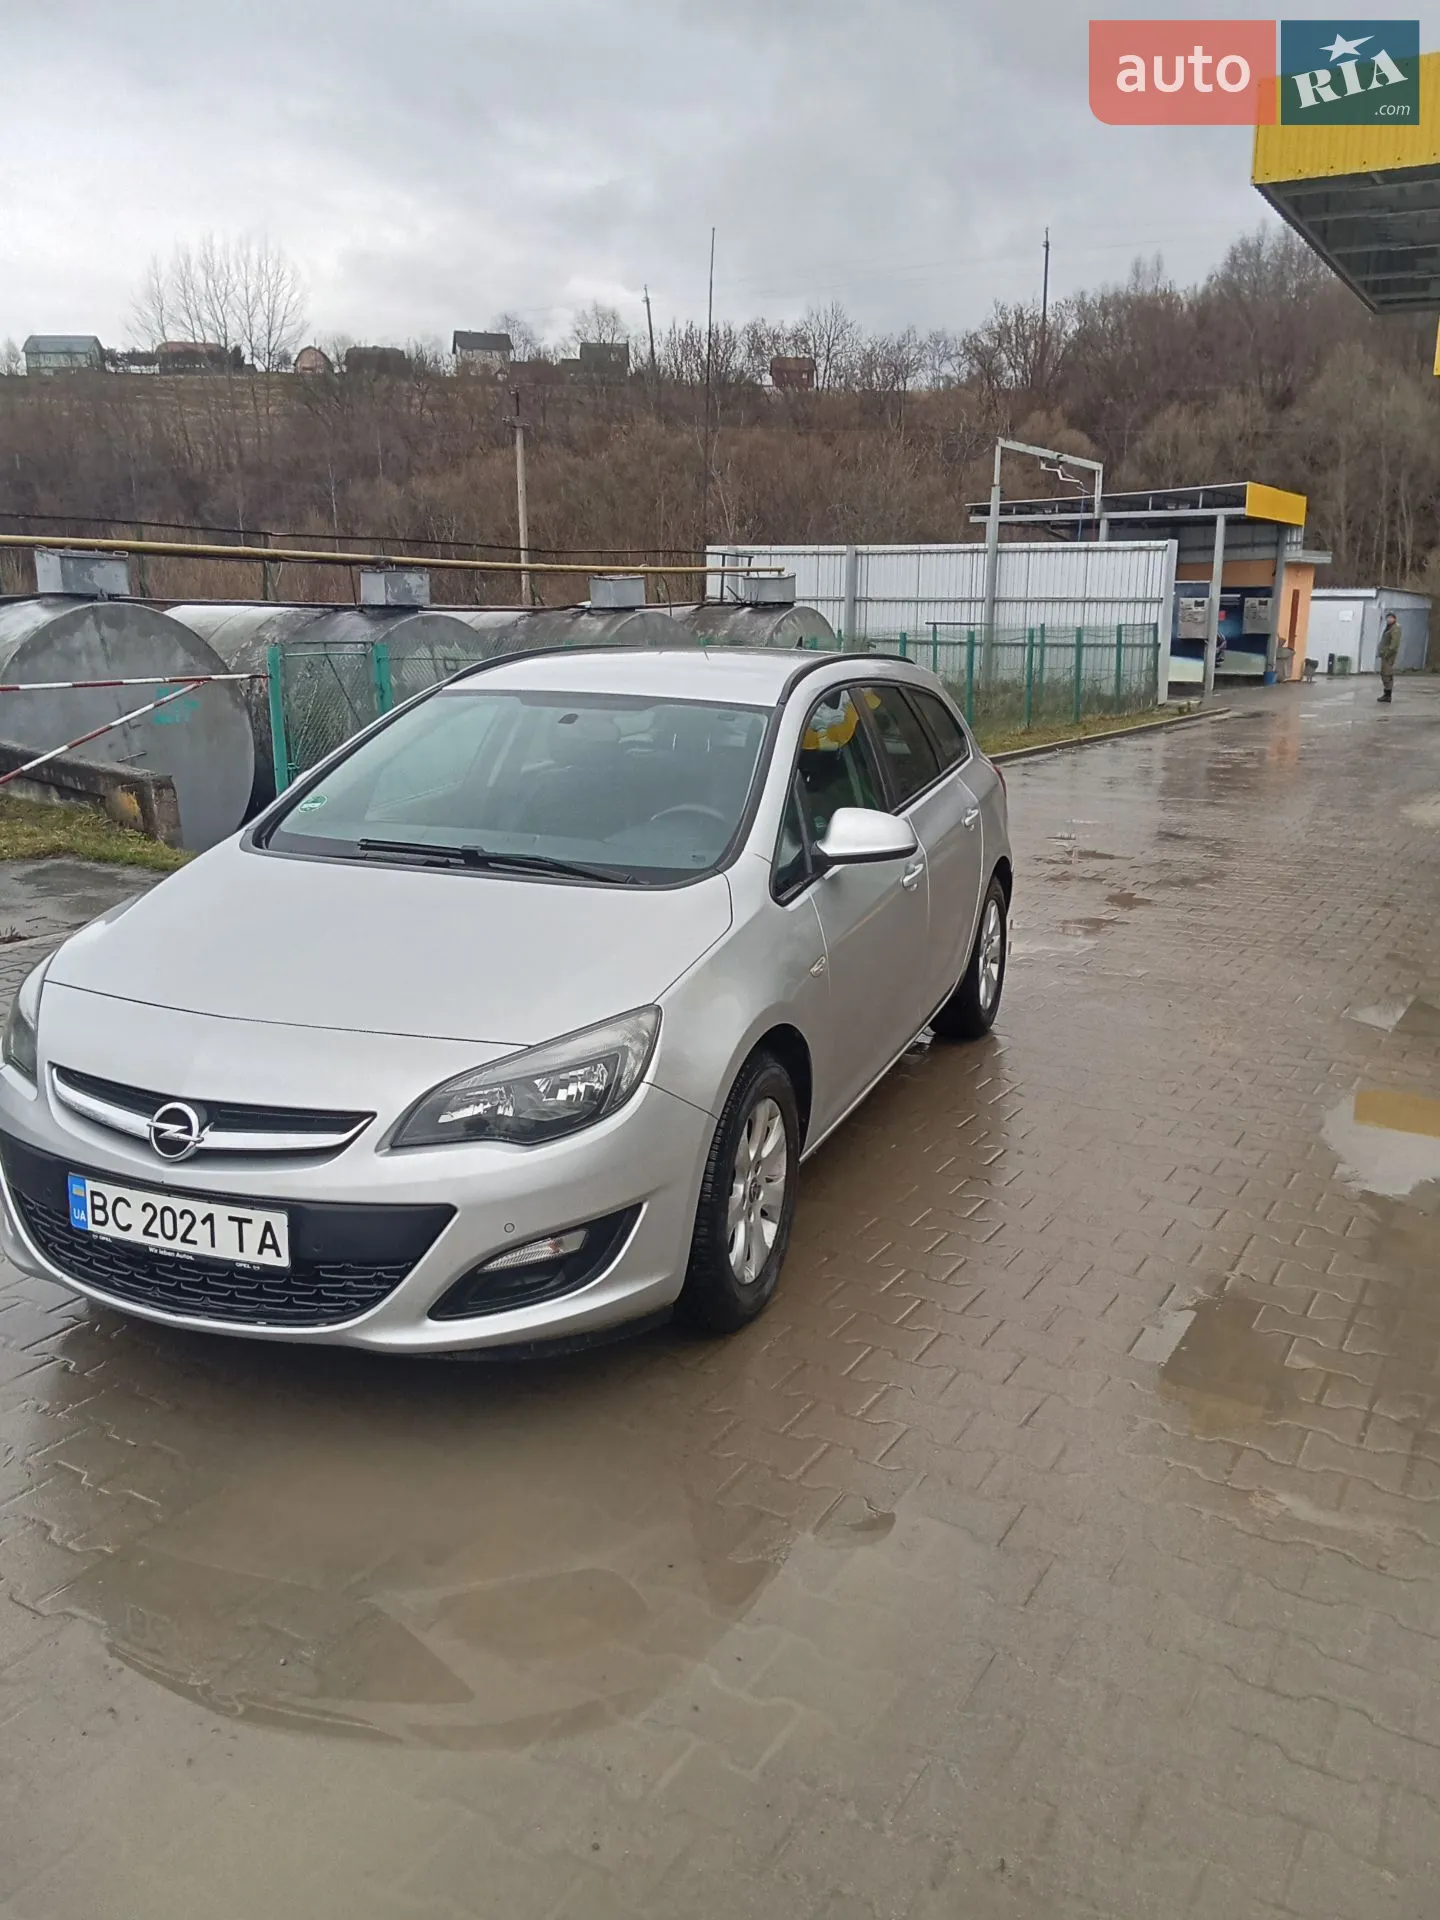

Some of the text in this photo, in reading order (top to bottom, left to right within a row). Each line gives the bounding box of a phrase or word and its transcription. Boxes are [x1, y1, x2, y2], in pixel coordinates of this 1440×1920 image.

[73, 1208, 88, 1223] UA
[89, 1189, 282, 1259] BC 2021 TA
